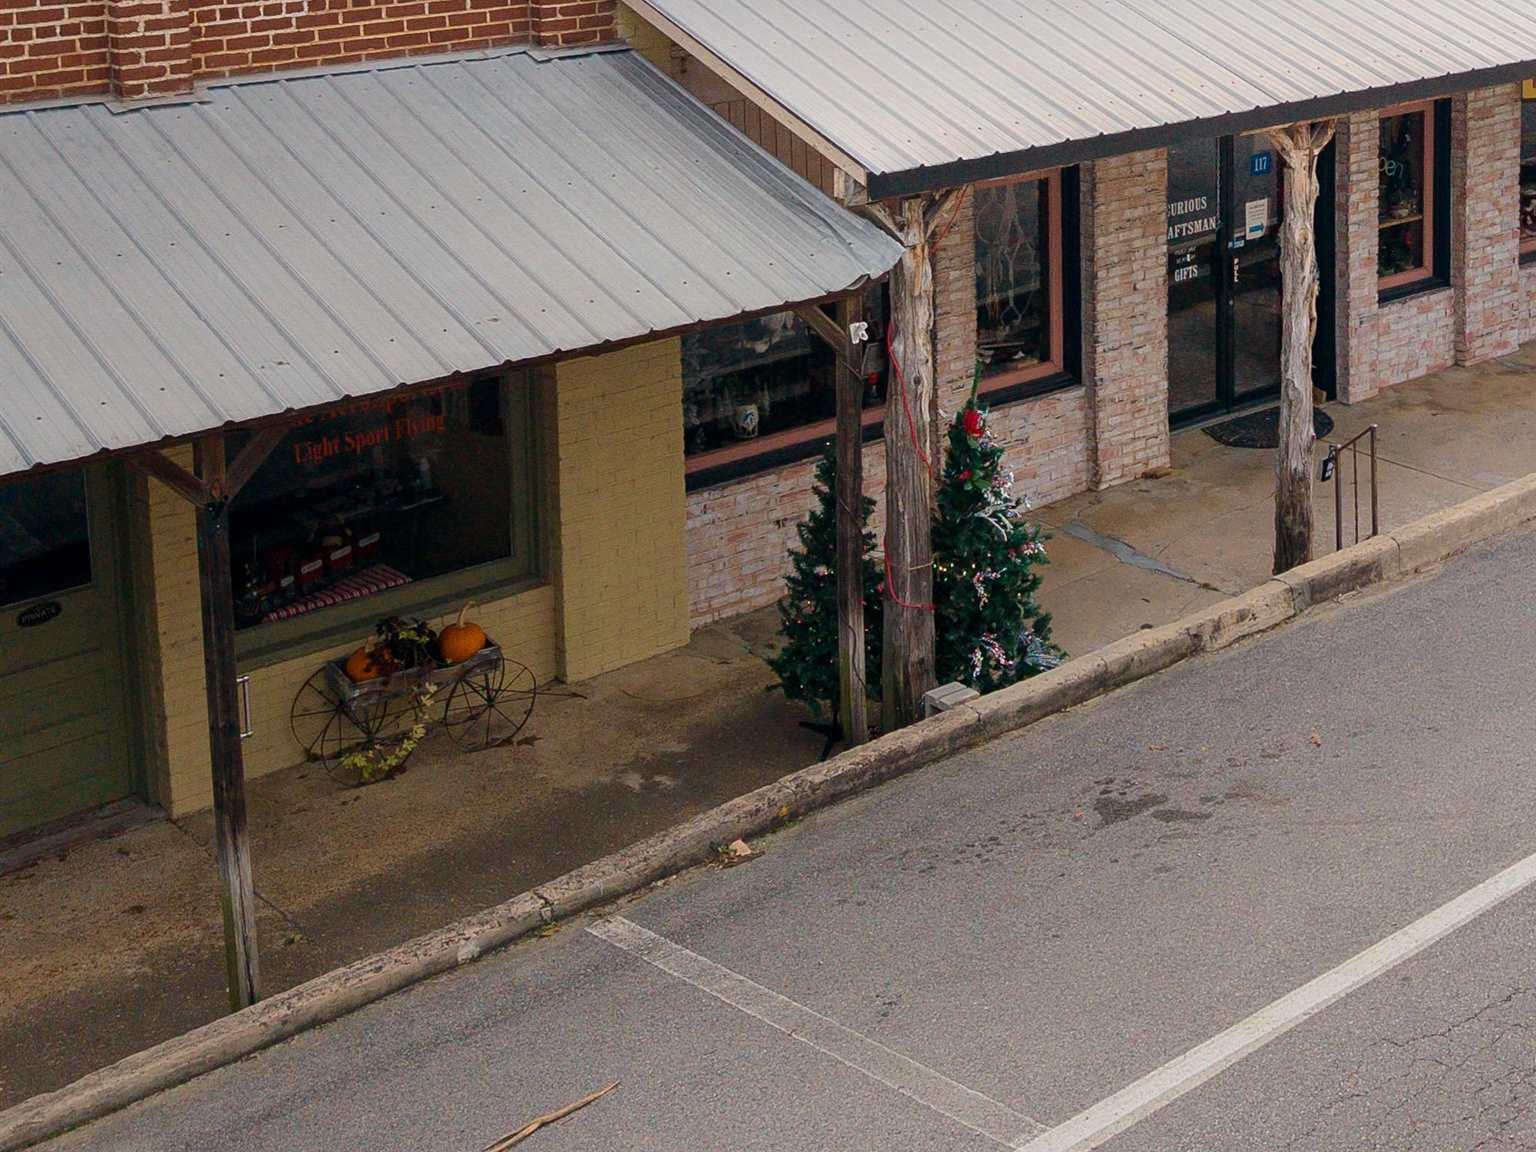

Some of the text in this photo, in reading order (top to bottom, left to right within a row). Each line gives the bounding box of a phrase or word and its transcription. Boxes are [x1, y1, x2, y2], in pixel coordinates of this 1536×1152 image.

[1255, 156, 1268, 171] 117
[1175, 264, 1198, 282] GIFTS
[292, 414, 446, 464] Light Sport Flying
